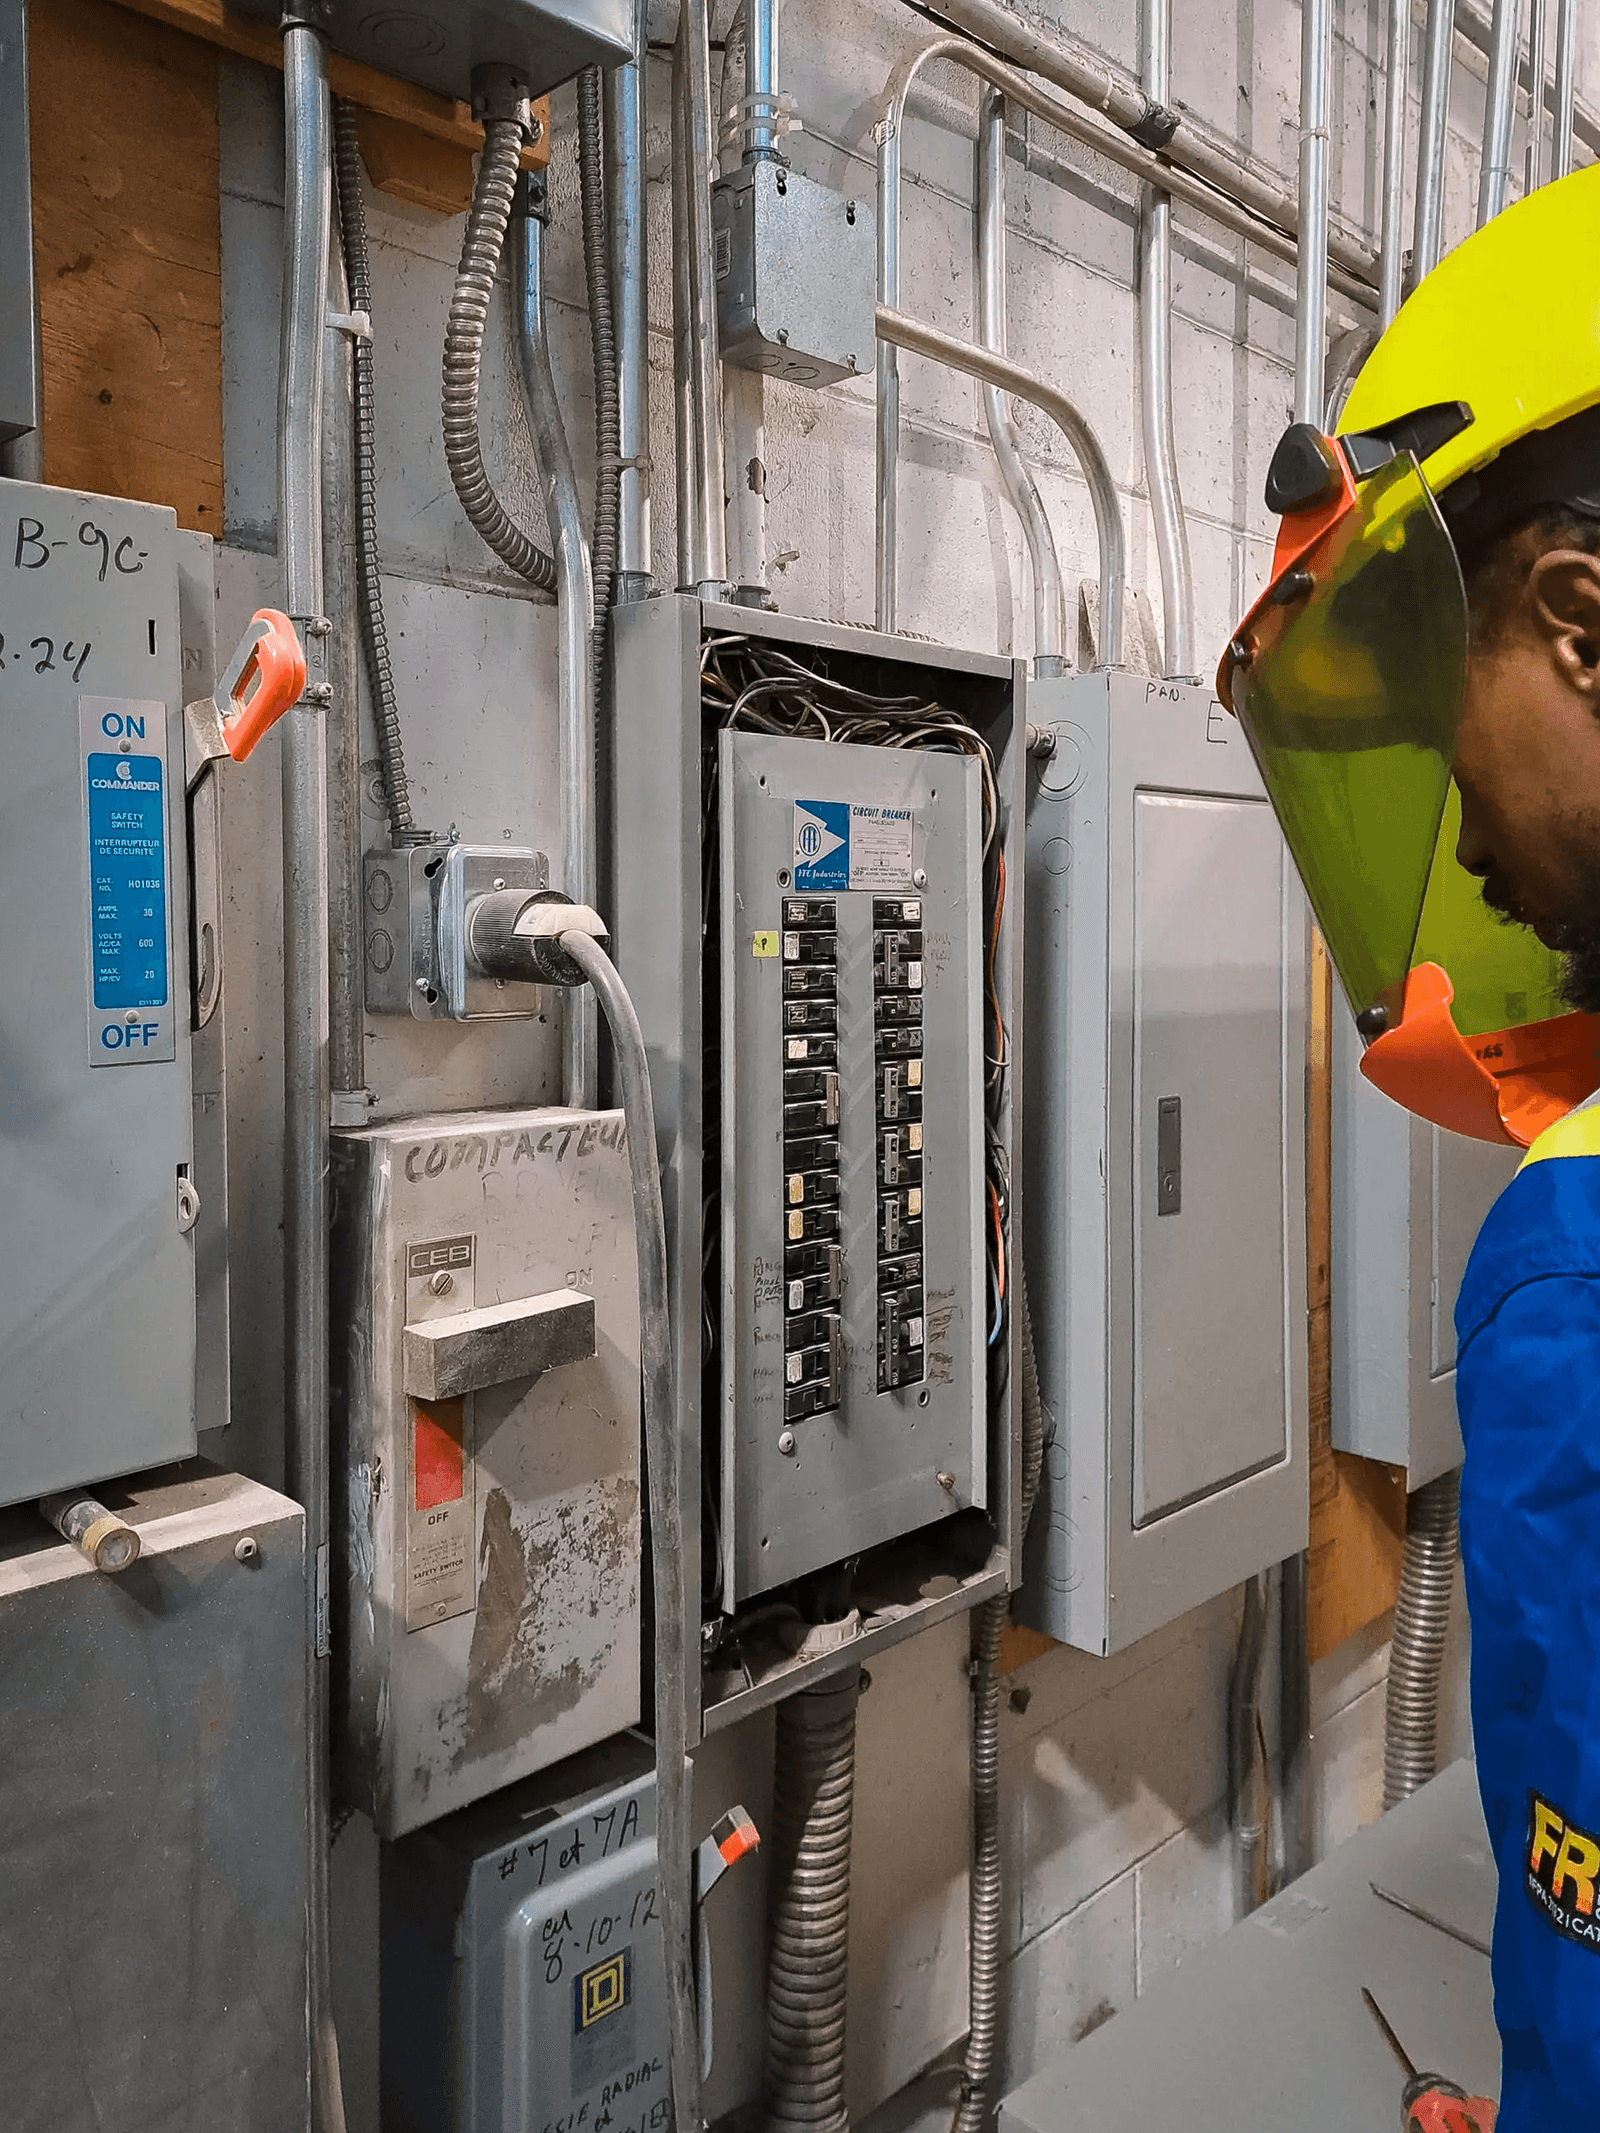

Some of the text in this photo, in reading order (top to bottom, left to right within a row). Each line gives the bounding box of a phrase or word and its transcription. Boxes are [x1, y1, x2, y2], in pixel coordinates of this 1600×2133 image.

[101, 712, 145, 739] ON
[1206, 699, 1228, 744] E
[91, 779, 160, 791] COMMANDER
[110, 812, 144, 821] SAFETY
[852, 806, 912, 821] CIRCUIT BREAKER
[111, 821, 143, 829] SWITCH
[94, 838, 160, 848] INTERRUPTEUR
[99, 848, 111, 856] DE
[96, 877, 113, 885] CAT.
[143, 907, 153, 918] 30
[98, 933, 123, 941] VOLTS
[138, 938, 154, 949] 600
[102, 948, 120, 956] MAX.
[144, 970, 155, 980] 20
[101, 1023, 159, 1049] OFF
[411, 1245, 470, 1269] CEB
[565, 1268, 593, 1289] ON
[428, 1511, 449, 1526] OFF
[413, 1558, 464, 1580] SAFETY SWITCH
